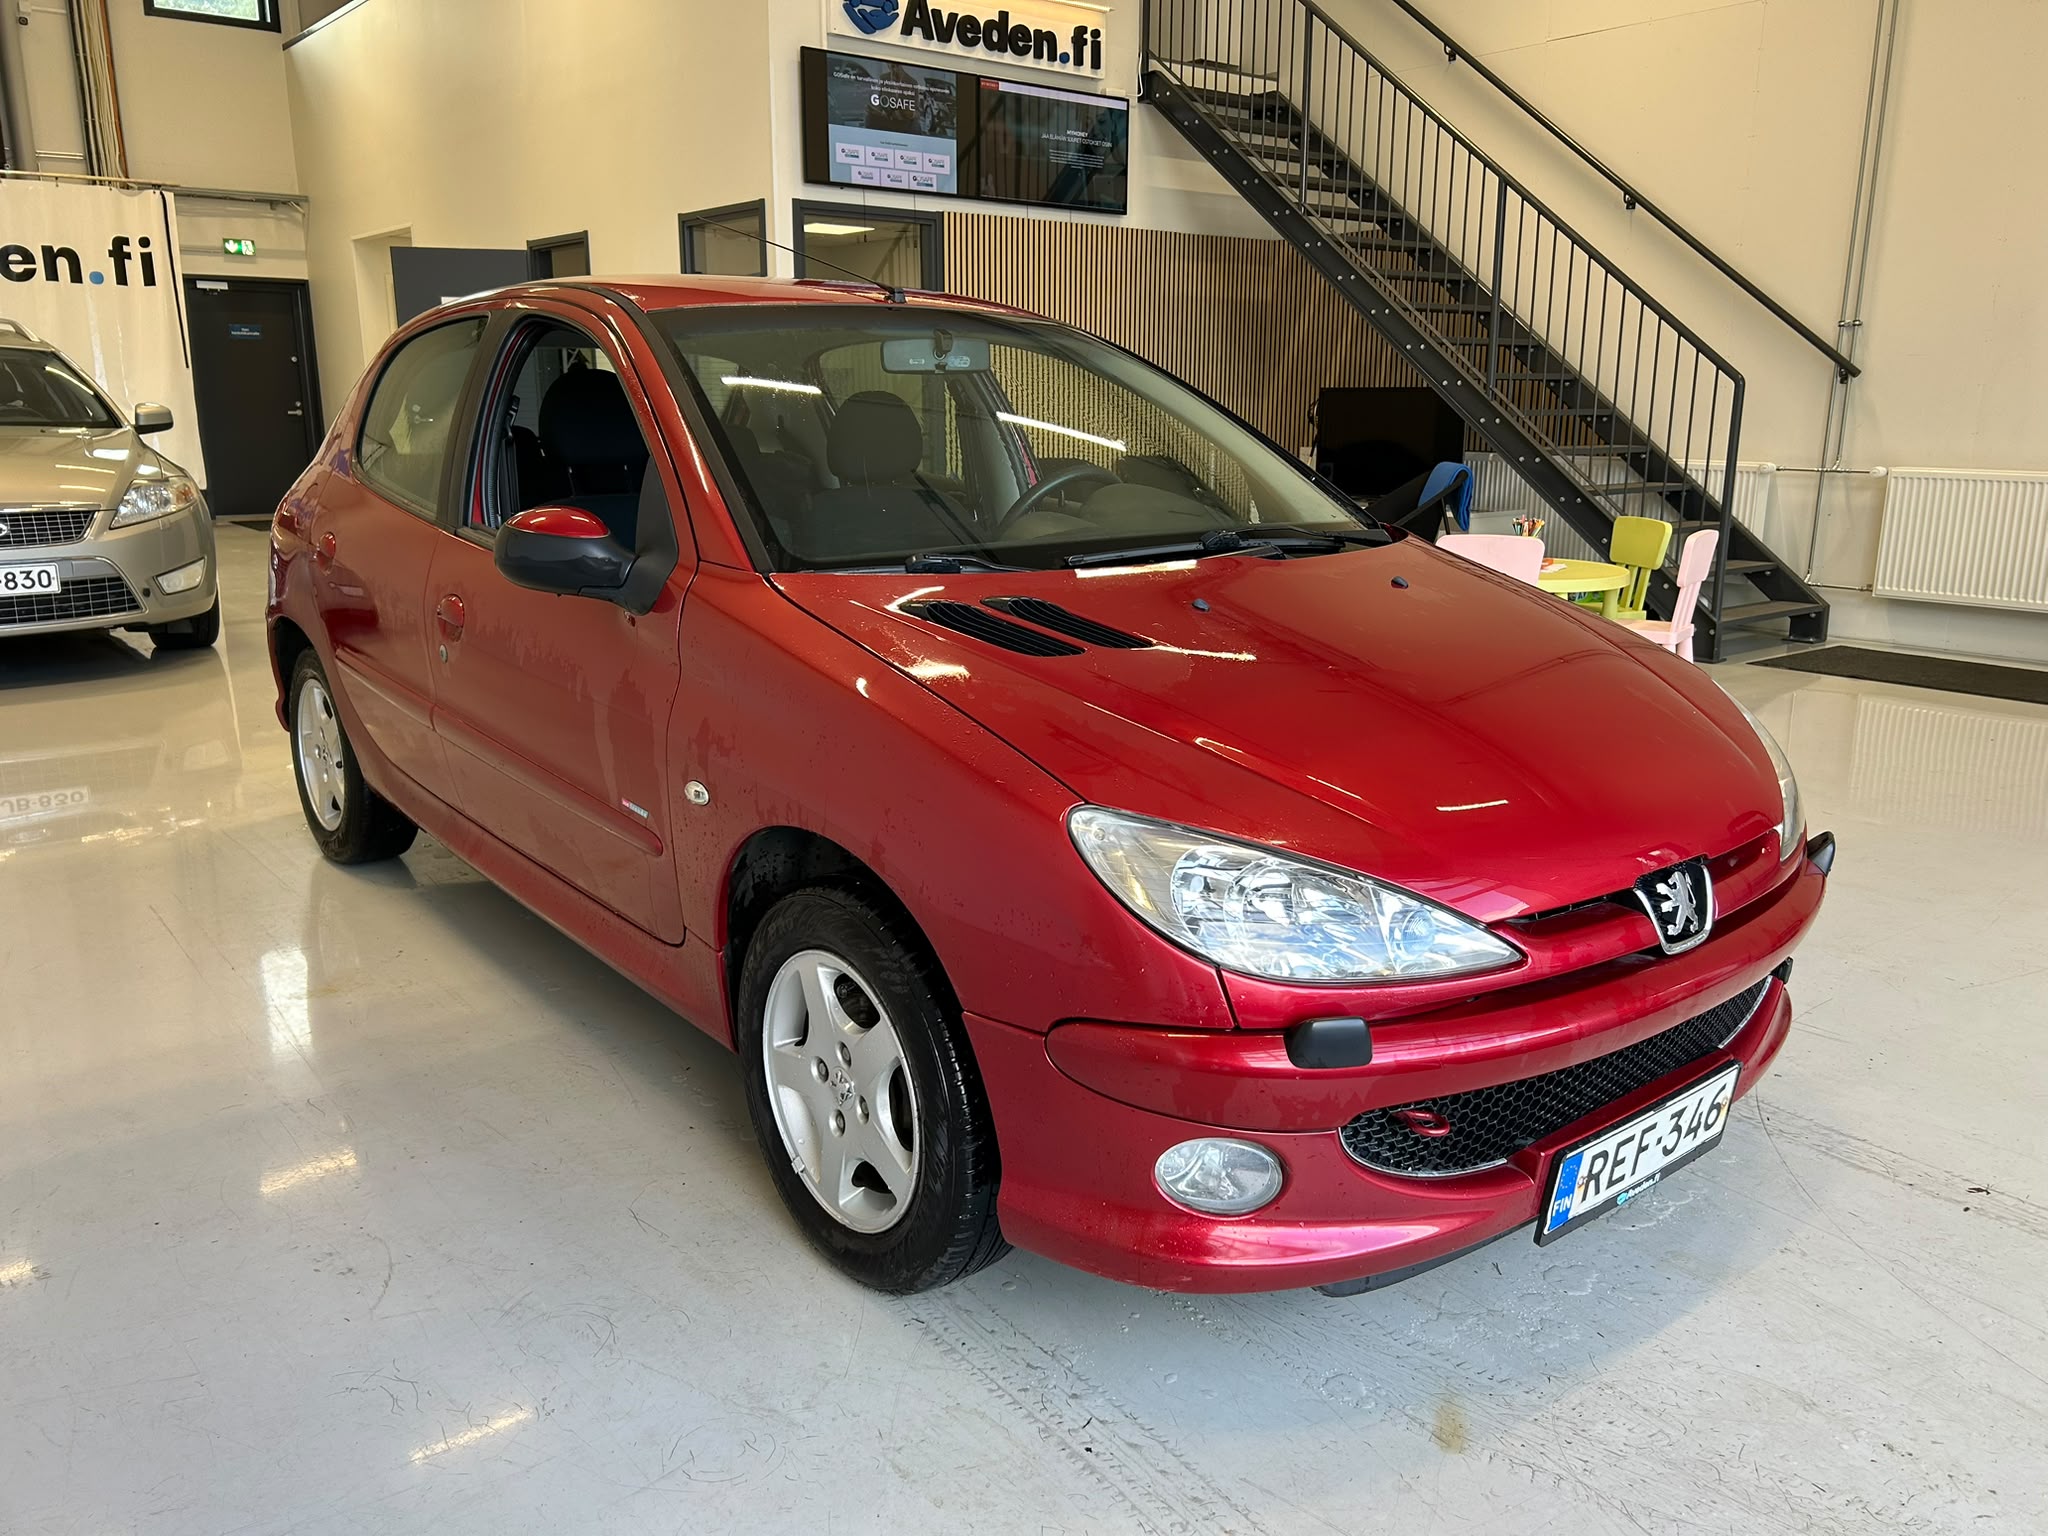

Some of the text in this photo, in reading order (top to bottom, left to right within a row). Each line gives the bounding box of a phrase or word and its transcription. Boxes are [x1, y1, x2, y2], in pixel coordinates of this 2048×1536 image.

[900, 0, 1101, 70] Aveden.fi
[871, 94, 915, 111] GOSAFE
[0, 235, 157, 287] en.fi
[0, 569, 52, 591] 830
[1581, 1083, 1727, 1204] REF-346
[1553, 1195, 1572, 1217] FIN
